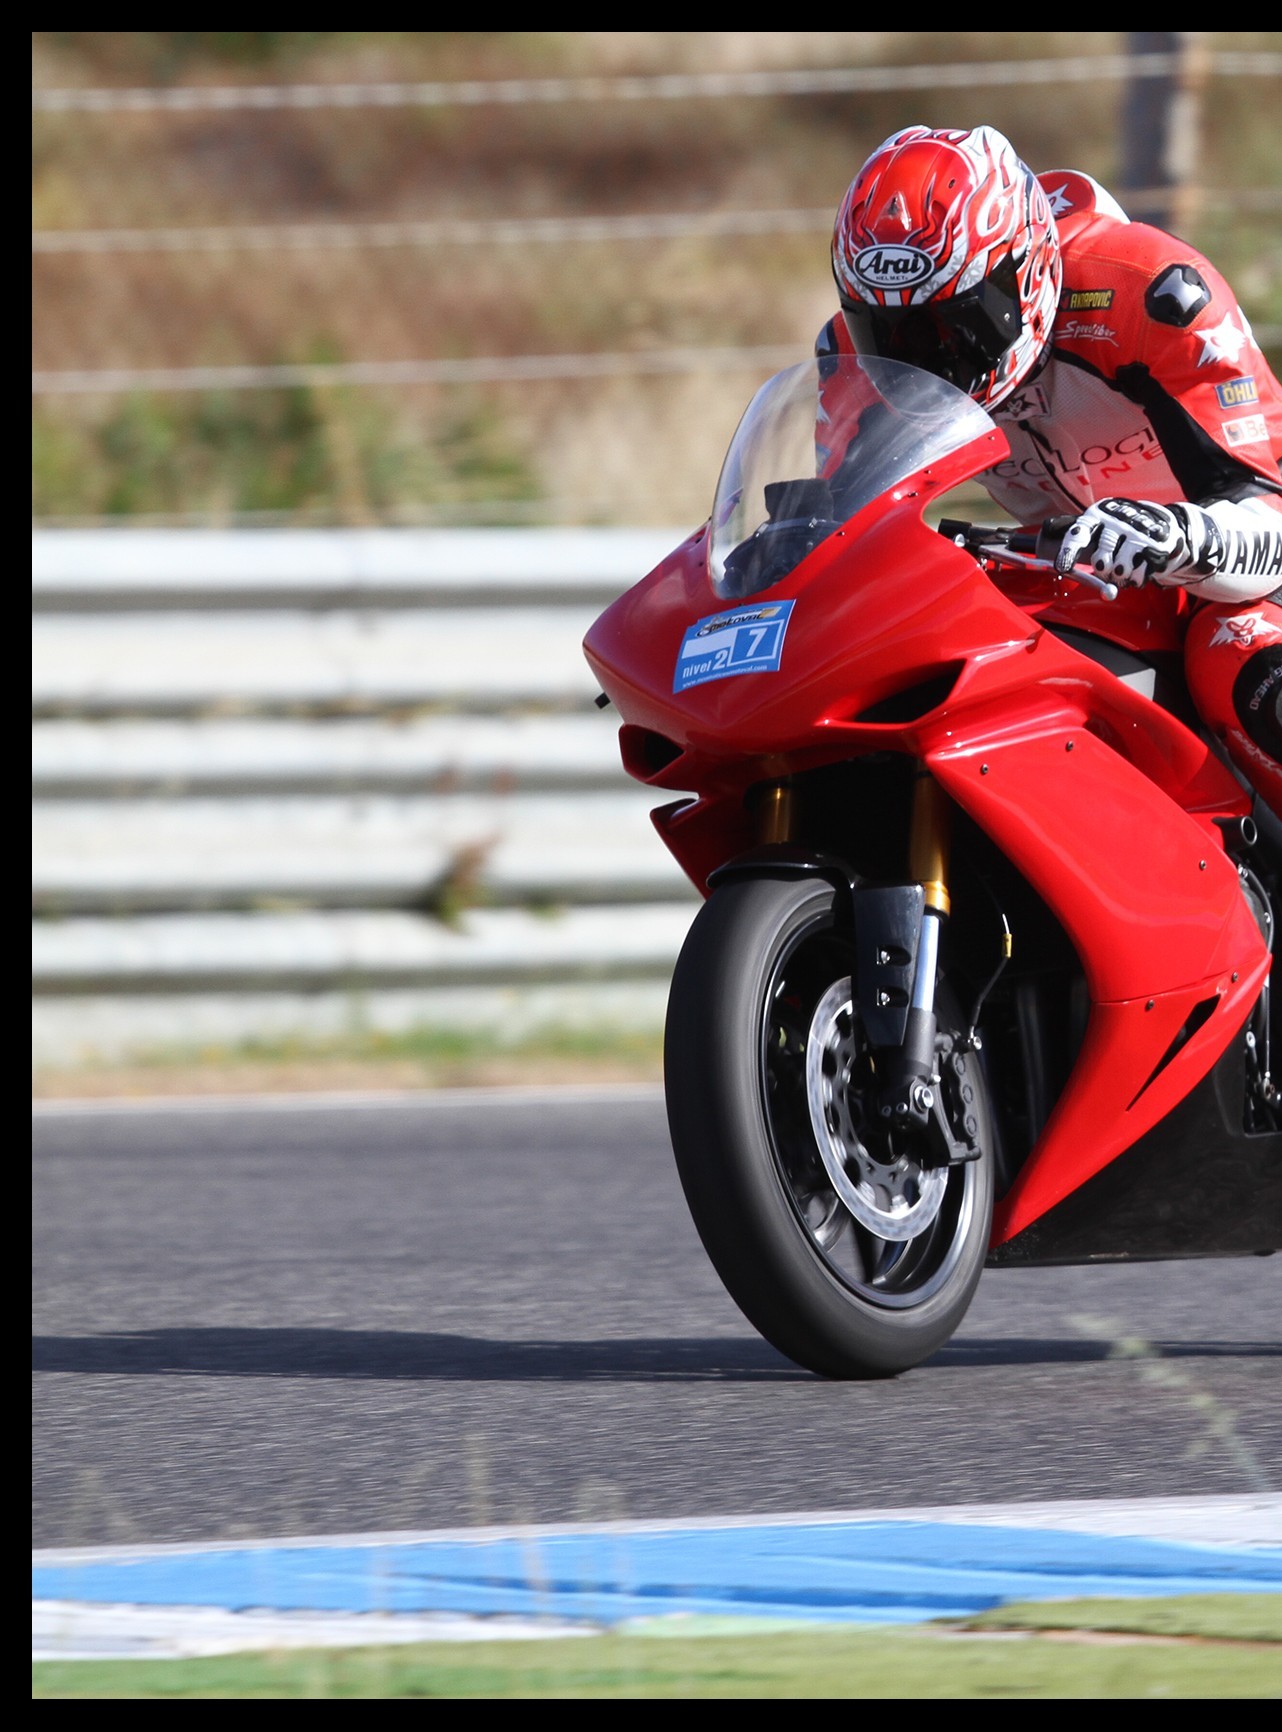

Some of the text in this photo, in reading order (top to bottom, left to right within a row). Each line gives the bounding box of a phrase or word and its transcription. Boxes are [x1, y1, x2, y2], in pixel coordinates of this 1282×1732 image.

[859, 251, 922, 275] Arai
[746, 626, 768, 658] 7
[682, 659, 712, 679] nivel
[712, 648, 729, 671] 2
